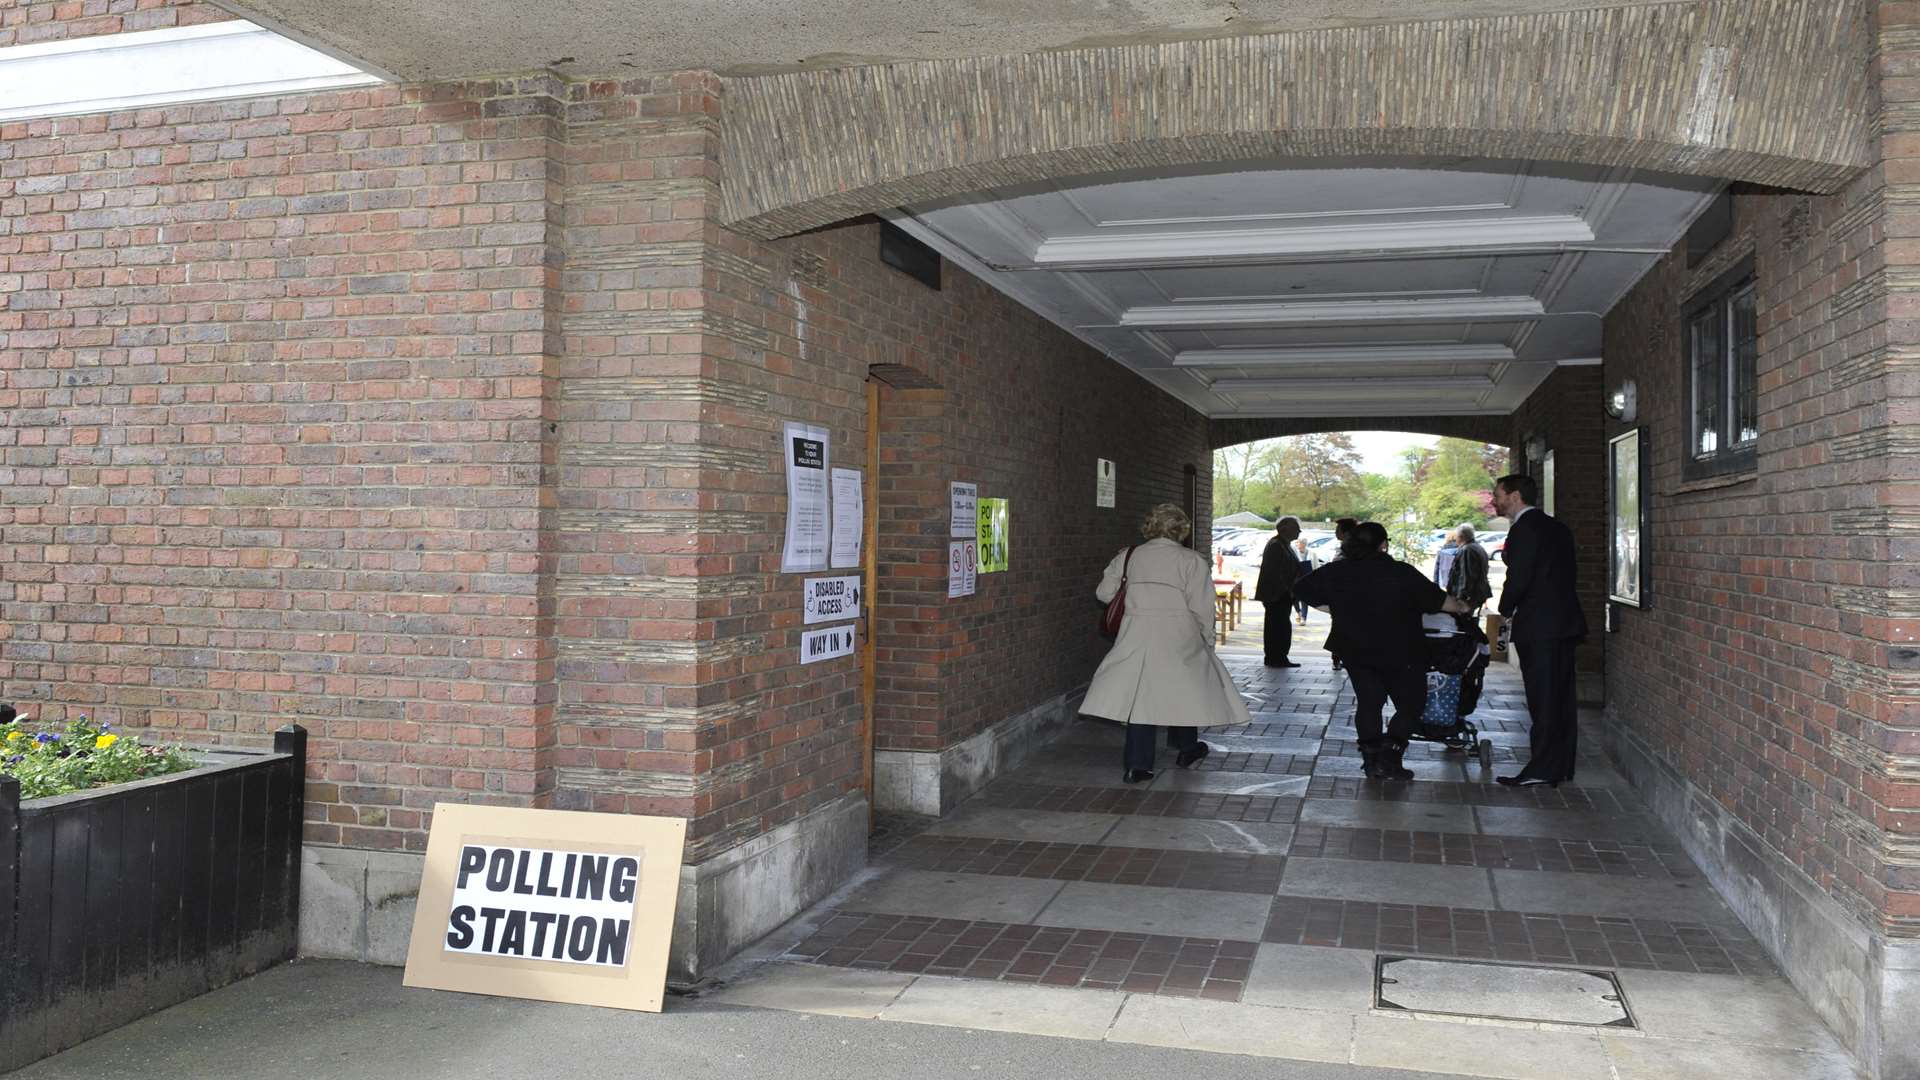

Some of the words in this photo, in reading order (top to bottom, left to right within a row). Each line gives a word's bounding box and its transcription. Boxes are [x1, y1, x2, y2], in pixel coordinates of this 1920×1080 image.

[981, 543, 1005, 566] OPN
[815, 581, 844, 597] DISABLED
[818, 599, 842, 615] ACCESS
[810, 634, 827, 656] WAY
[830, 632, 840, 652] IN
[456, 846, 638, 904] POLLING
[447, 905, 630, 965] STATION
